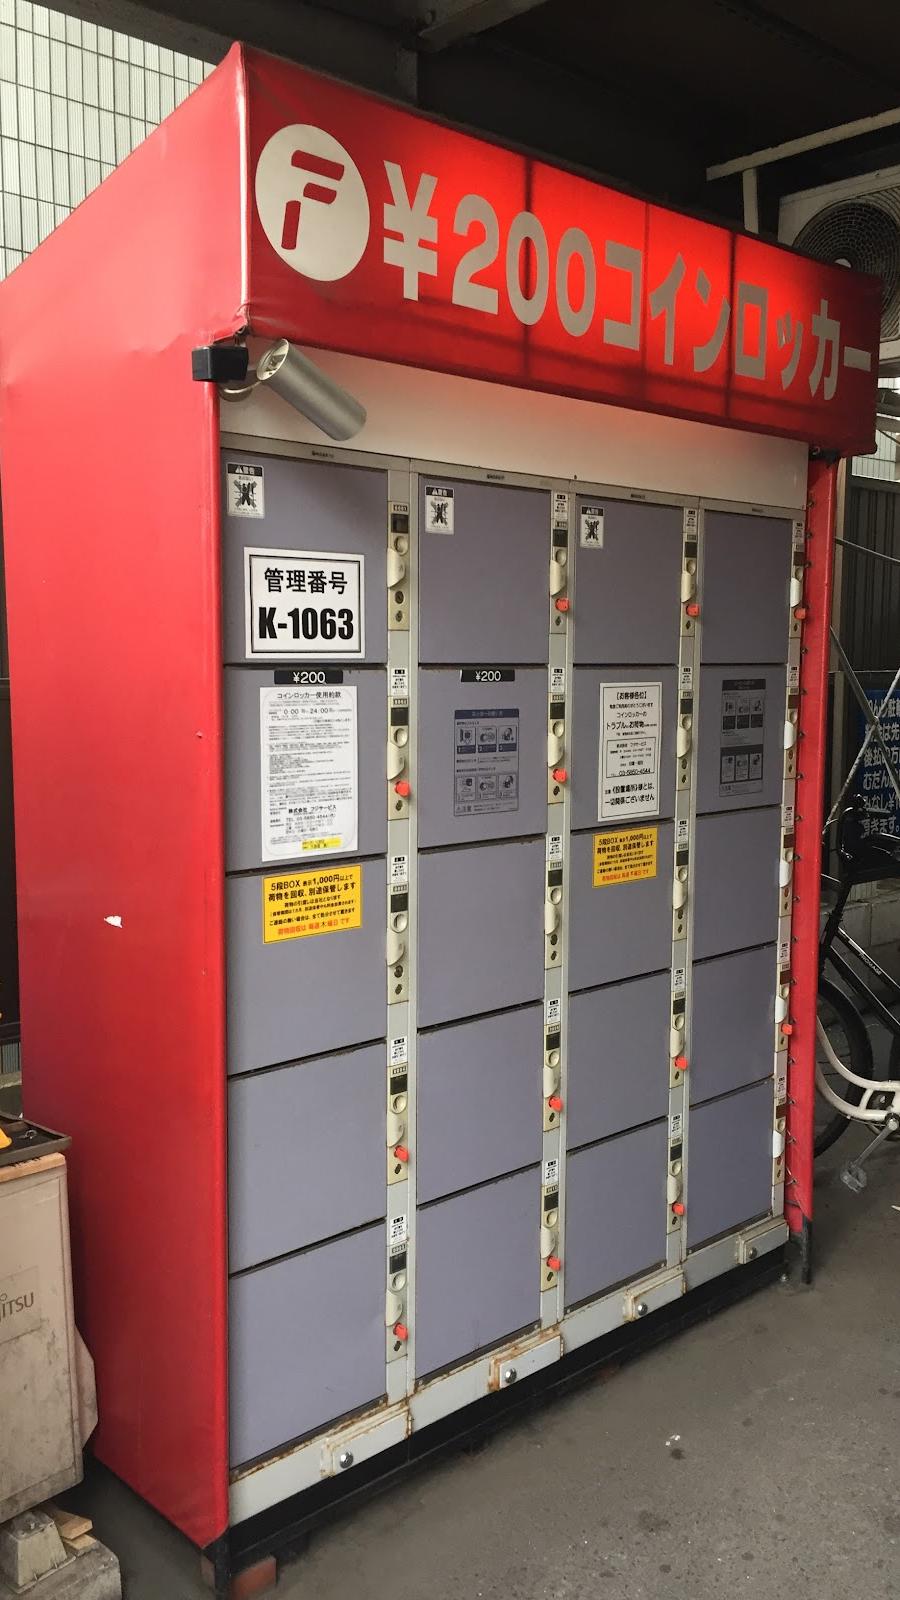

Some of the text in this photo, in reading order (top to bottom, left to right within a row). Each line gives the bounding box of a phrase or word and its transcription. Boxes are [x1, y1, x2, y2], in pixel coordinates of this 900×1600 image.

[383, 160, 872, 401] ¥200コインロッカー
[264, 567, 348, 595] 管理番号
[258, 606, 355, 640] K-1063
[293, 671, 326, 684] ¥200
[475, 670, 502, 682] ¥200
[0, 1291, 34, 1322] ITSU
